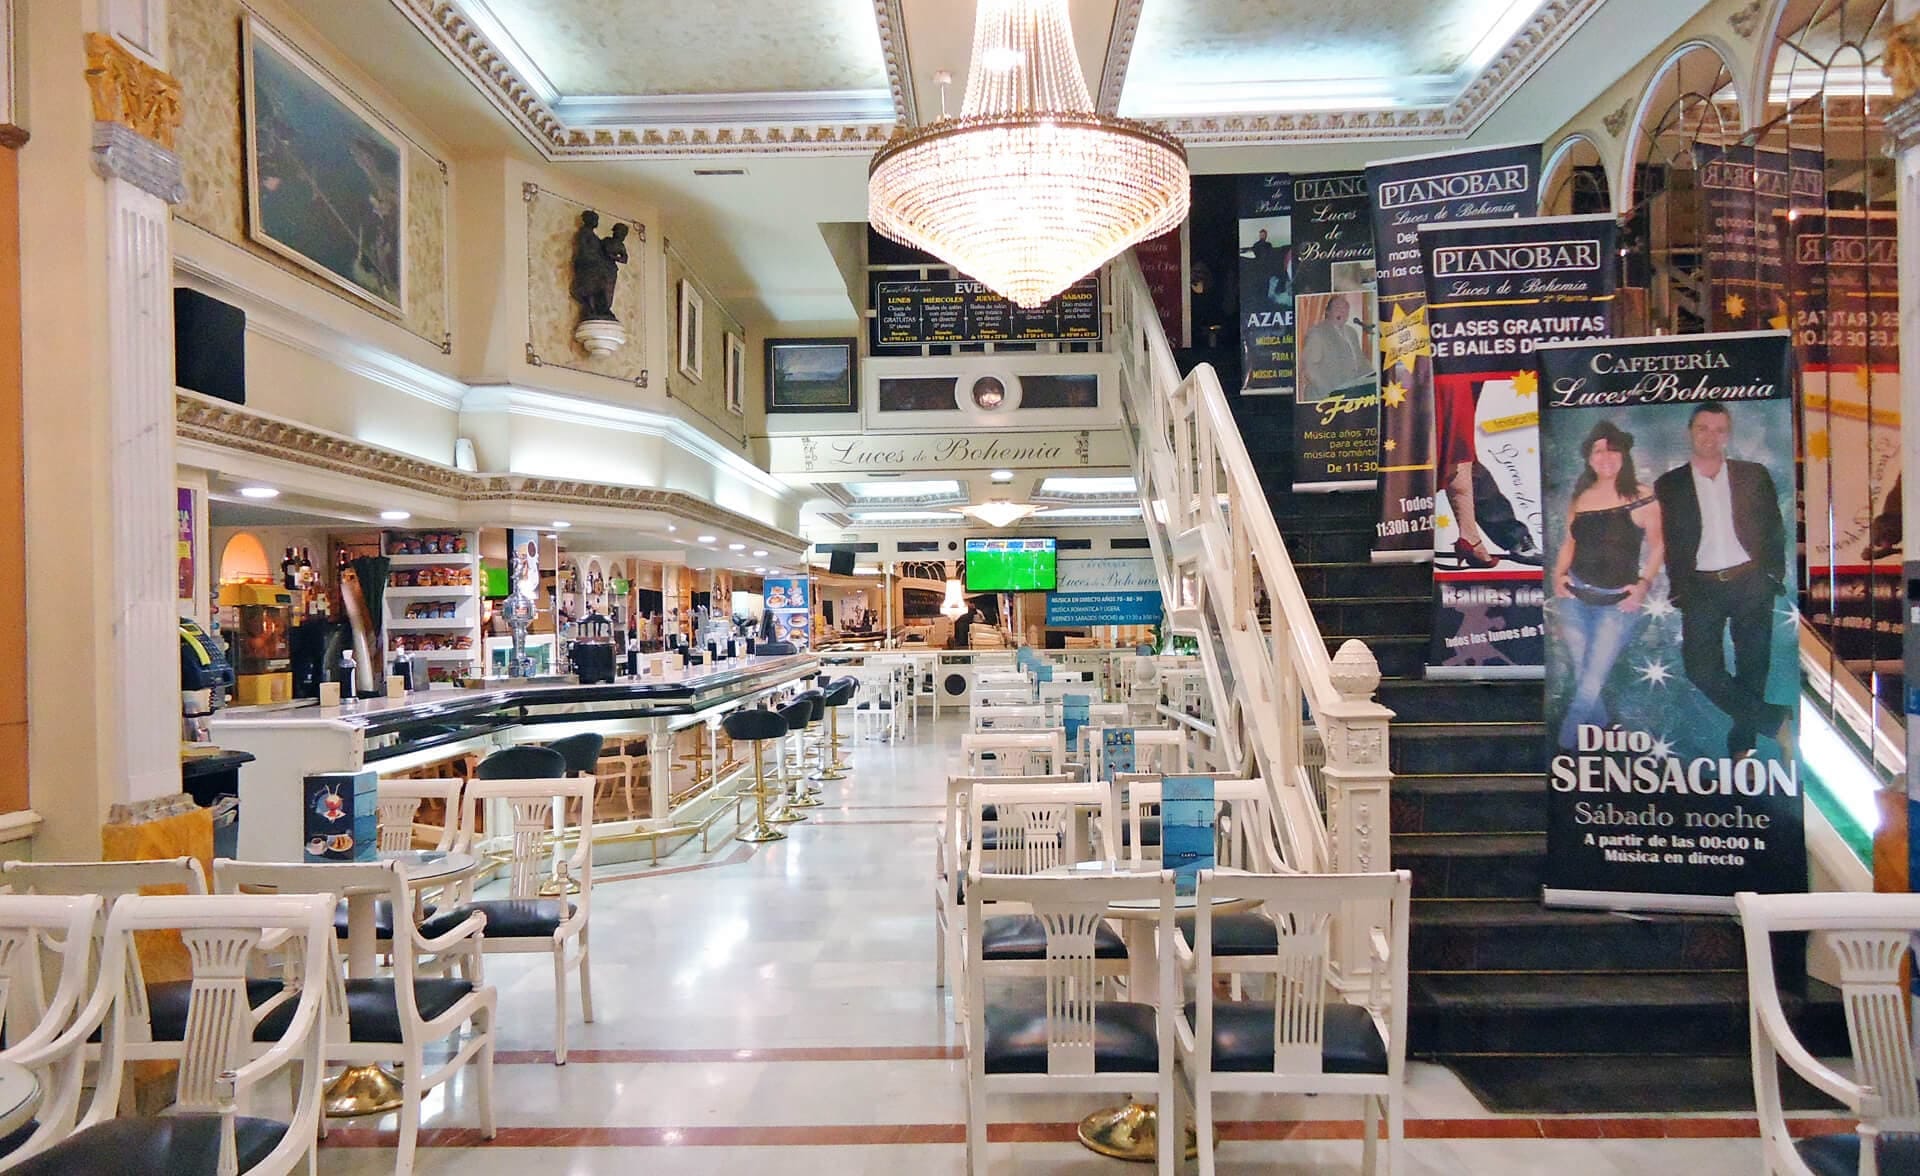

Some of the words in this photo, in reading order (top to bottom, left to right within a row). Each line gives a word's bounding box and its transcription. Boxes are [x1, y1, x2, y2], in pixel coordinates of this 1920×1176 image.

[1384, 170, 1523, 206] PIANOBAR
[1310, 205, 1357, 223] Luces
[1392, 209, 1429, 226] Luces
[1434, 206, 1448, 220] de
[1455, 202, 1517, 218] Bohemia
[1324, 223, 1344, 240] de
[1298, 242, 1373, 263] Bohemia
[1440, 246, 1594, 274] PIANOBAR
[1392, 266, 1407, 278] las
[1448, 280, 1490, 297] Luces
[1496, 279, 1512, 294] de
[1520, 277, 1589, 294] Bohemia
[1431, 320, 1498, 338] CLASES
[1504, 316, 1605, 335] GRATUITAS
[1453, 338, 1516, 356] BAILES
[1590, 350, 1730, 375] CAFETERÍA
[1551, 377, 1629, 408] Luces
[1626, 384, 1645, 397] de
[1638, 372, 1775, 403] Bohemia
[1339, 429, 1362, 439] años
[832, 439, 904, 465] Luces
[912, 449, 927, 463] de
[934, 437, 1062, 462] Bohemia
[1330, 440, 1351, 450] para
[1327, 464, 1342, 473] De
[1346, 461, 1378, 473] 11:30
[1400, 496, 1433, 513] Todos
[1411, 520, 1418, 531] a
[1442, 585, 1512, 607] Bailes
[1515, 584, 1544, 606] de
[1445, 637, 1469, 648] Todos
[1470, 633, 1487, 644] los
[1488, 628, 1520, 642] lunes
[1521, 626, 1537, 638] de
[1577, 724, 1651, 753] Dúo
[1551, 749, 1798, 797] SENSACIÓN
[1575, 801, 1674, 827] Sábado
[1684, 805, 1771, 830] noche
[1584, 833, 1595, 845] A
[1599, 832, 1644, 849] partir
[1648, 834, 1668, 847] de
[1672, 835, 1695, 849] las
[1699, 836, 1750, 850] 00:00
[1754, 837, 1765, 851] h
[1604, 849, 1660, 863] Música
[1664, 853, 1683, 864] en
[1688, 851, 1744, 866] directo
